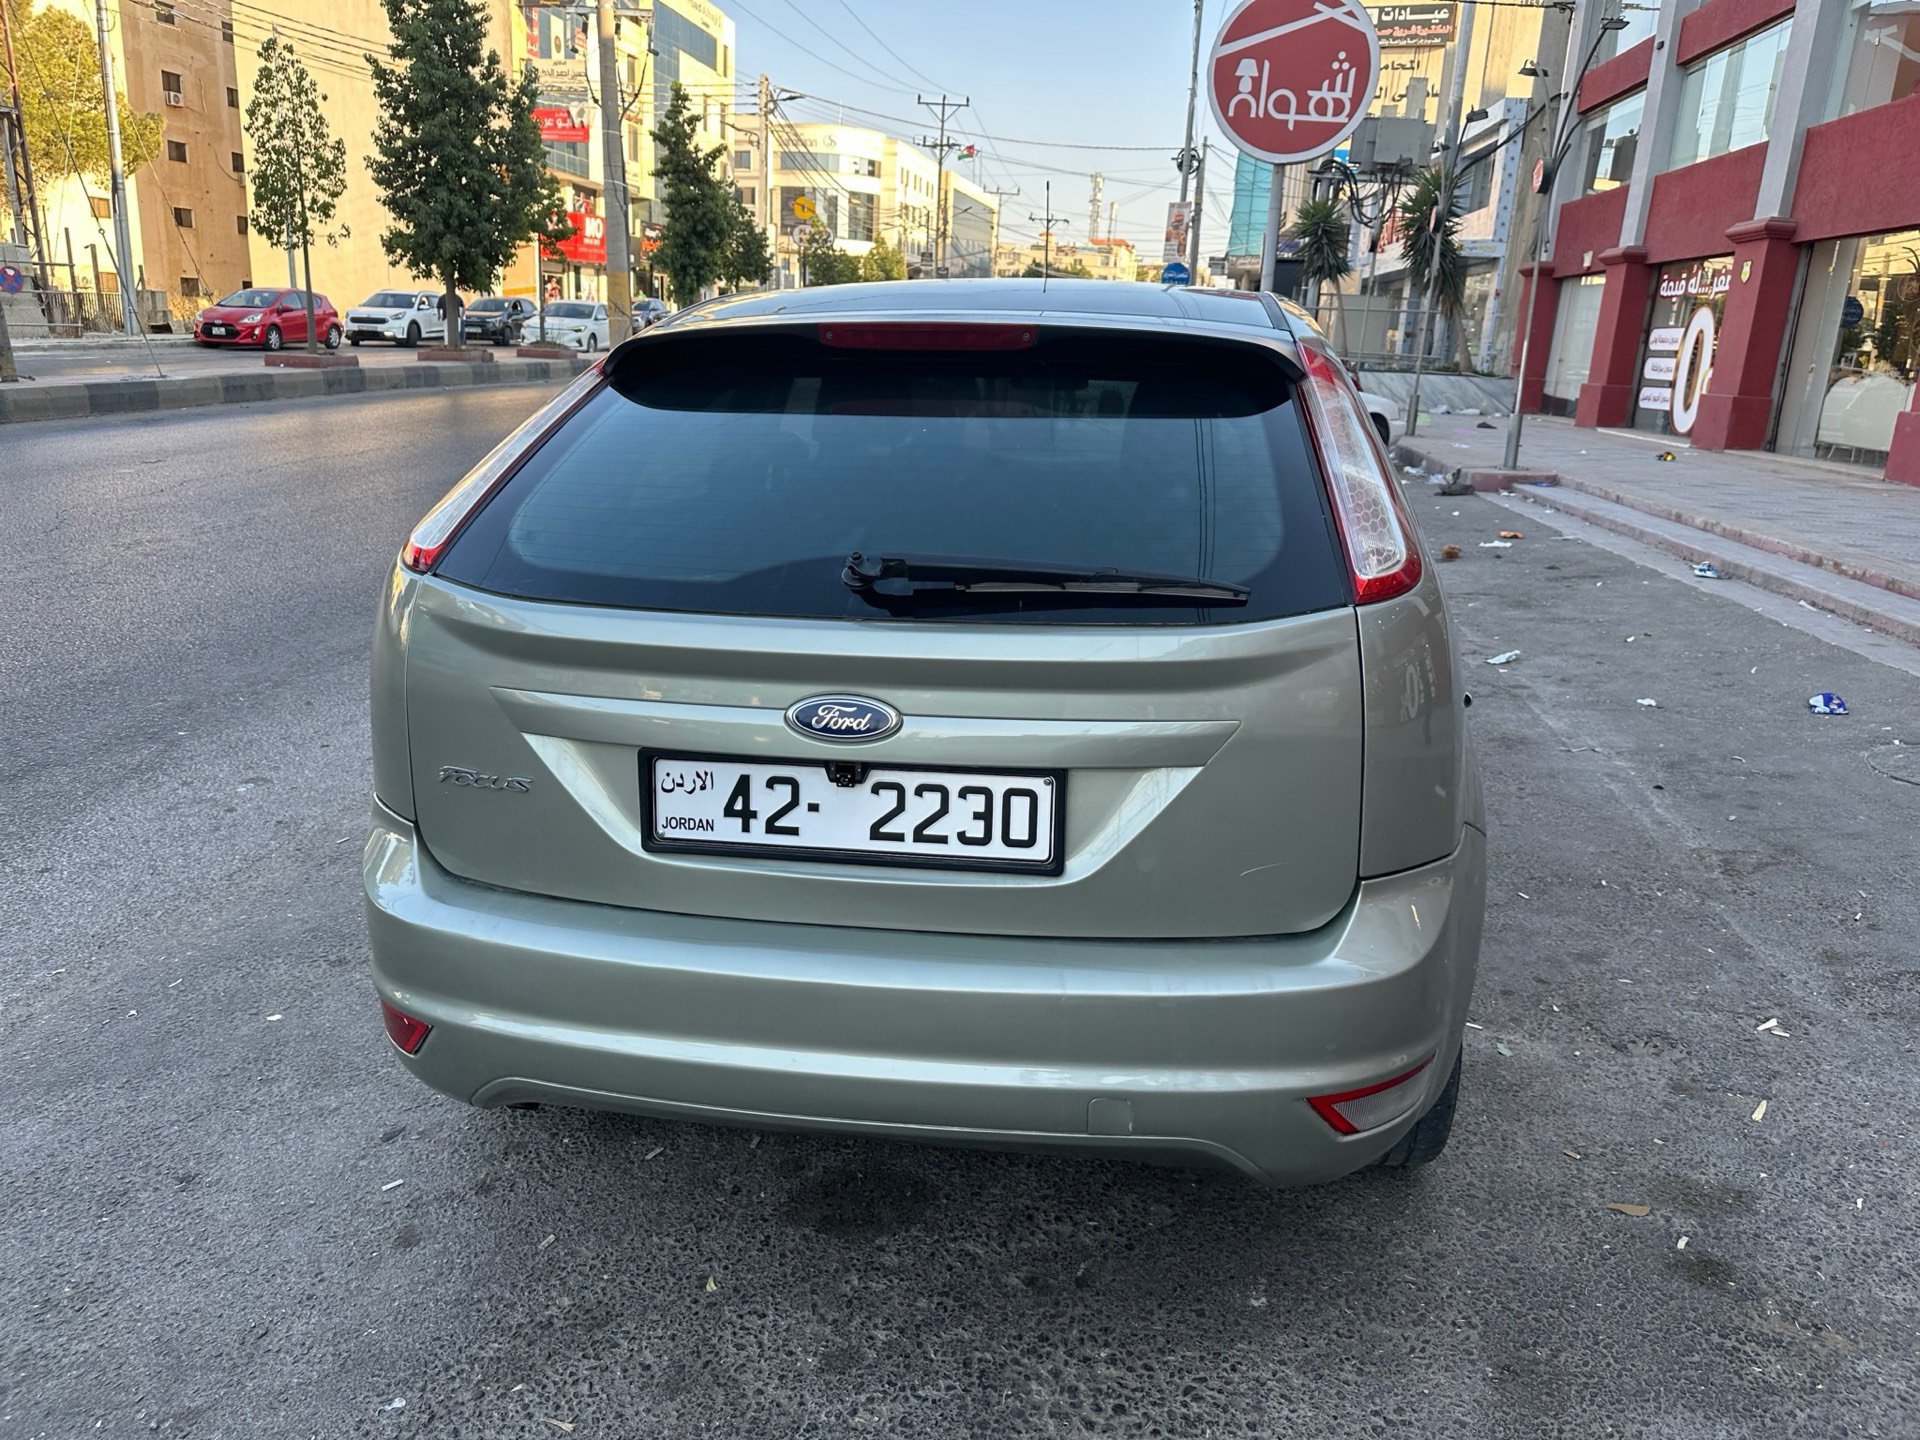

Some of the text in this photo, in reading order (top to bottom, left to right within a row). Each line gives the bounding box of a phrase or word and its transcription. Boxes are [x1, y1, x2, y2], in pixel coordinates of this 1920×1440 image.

[1381, 7, 1449, 23] عيادات
[811, 703, 871, 732] Ford
[661, 816, 715, 833] JORDAN
[869, 781, 1039, 849] 2230
